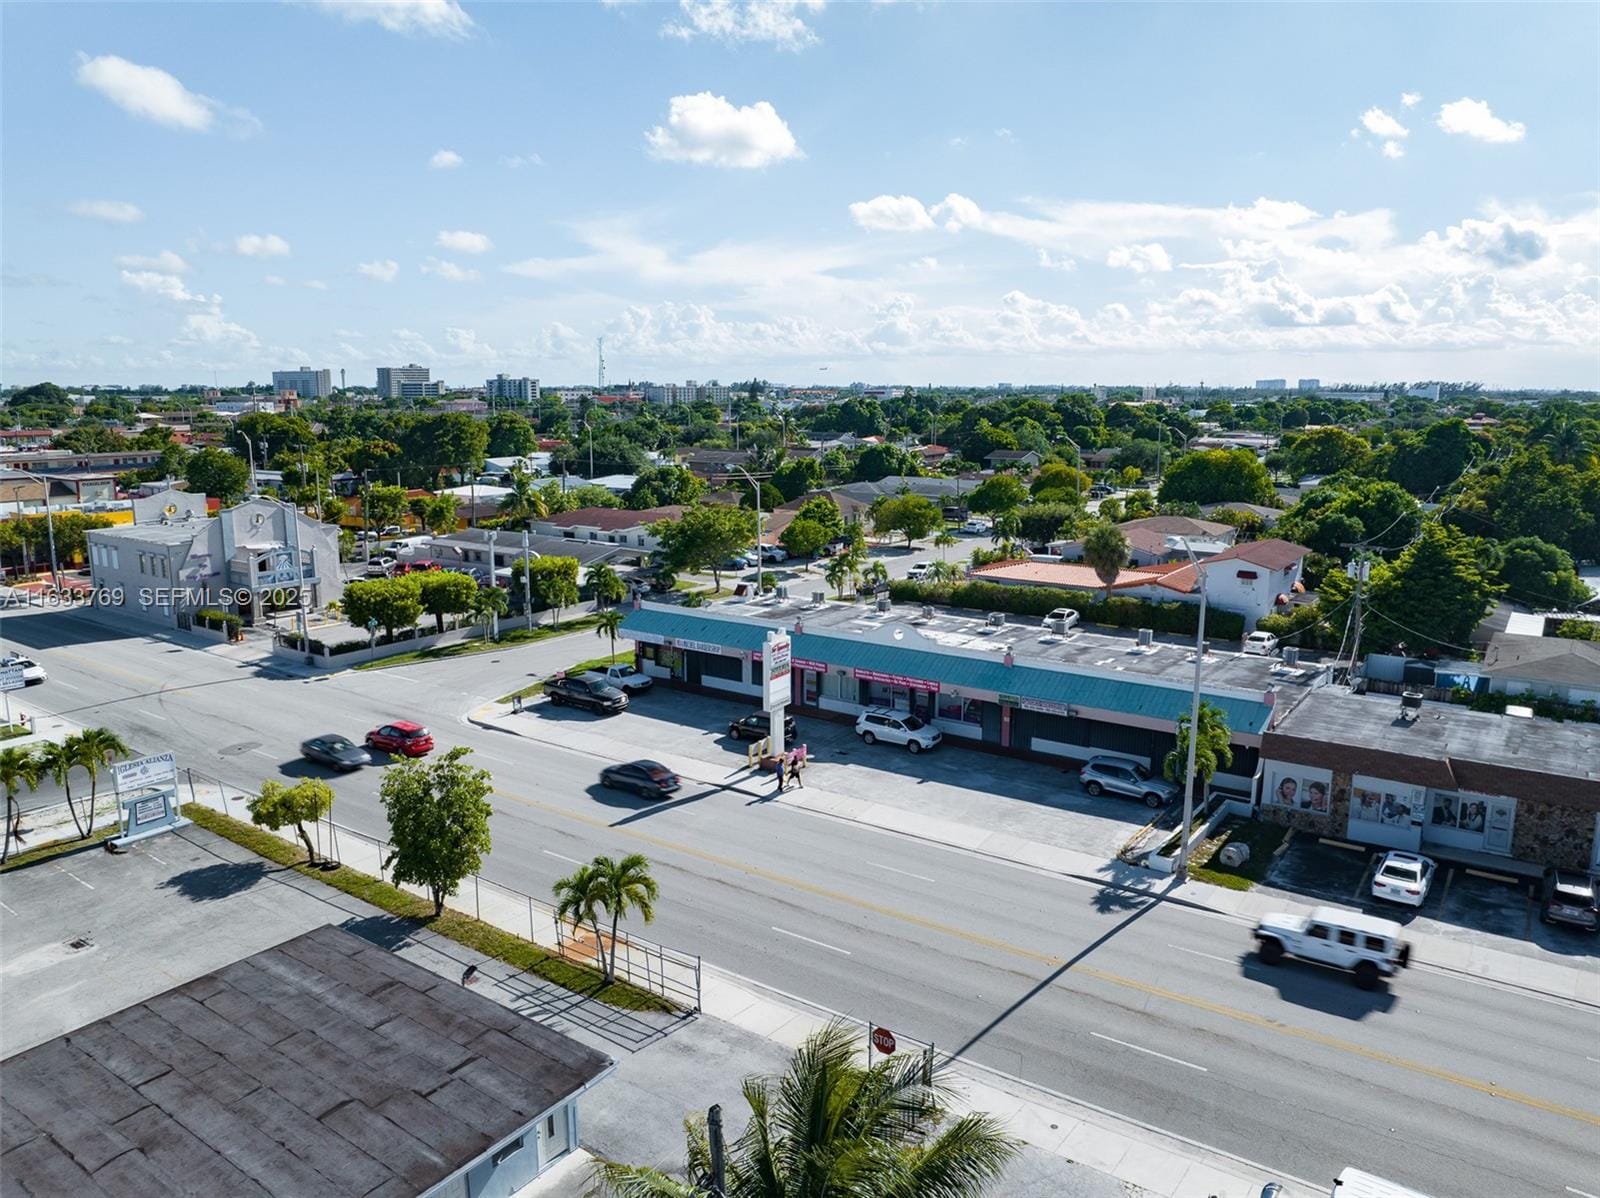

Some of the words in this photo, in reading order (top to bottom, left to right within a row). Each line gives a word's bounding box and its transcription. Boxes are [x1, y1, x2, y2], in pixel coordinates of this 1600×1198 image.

[117, 760, 144, 775] IGLESIA
[144, 753, 174, 765] ALIANZA
[873, 1033, 895, 1048] STOP
